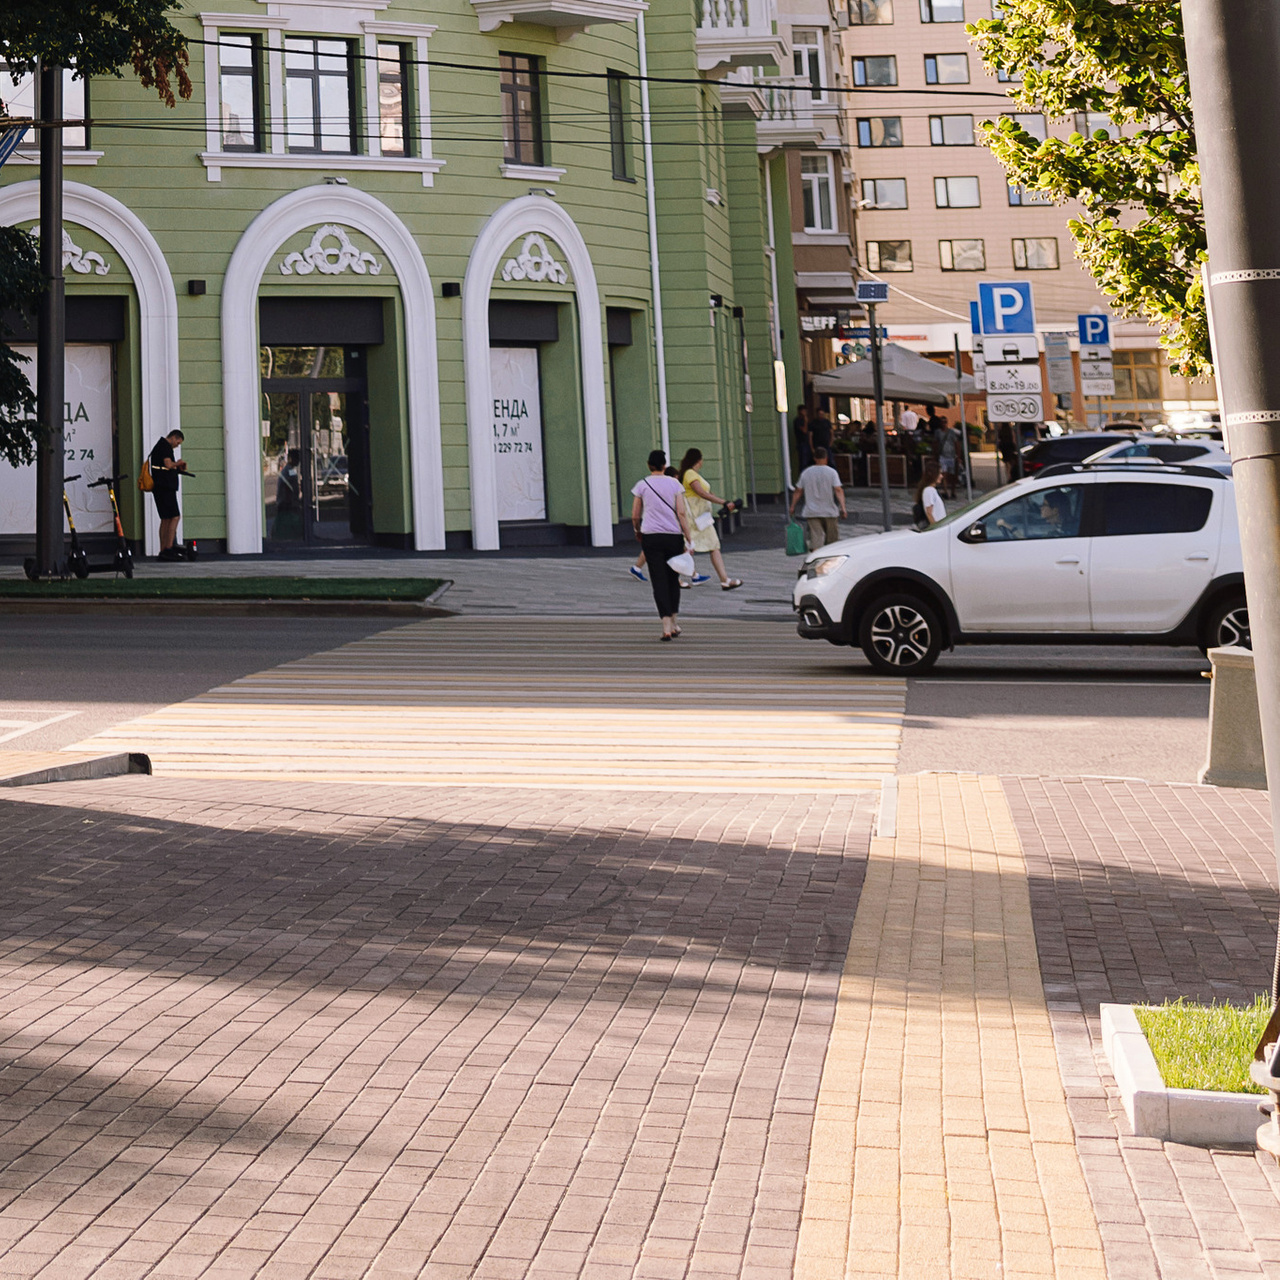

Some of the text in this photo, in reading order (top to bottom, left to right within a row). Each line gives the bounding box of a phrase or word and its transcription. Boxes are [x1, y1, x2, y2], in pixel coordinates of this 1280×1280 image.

[992, 287, 1024, 330] P
[1085, 317, 1105, 342] P
[1020, 402, 1036, 415] 20
[79, 448, 95, 461] 74
